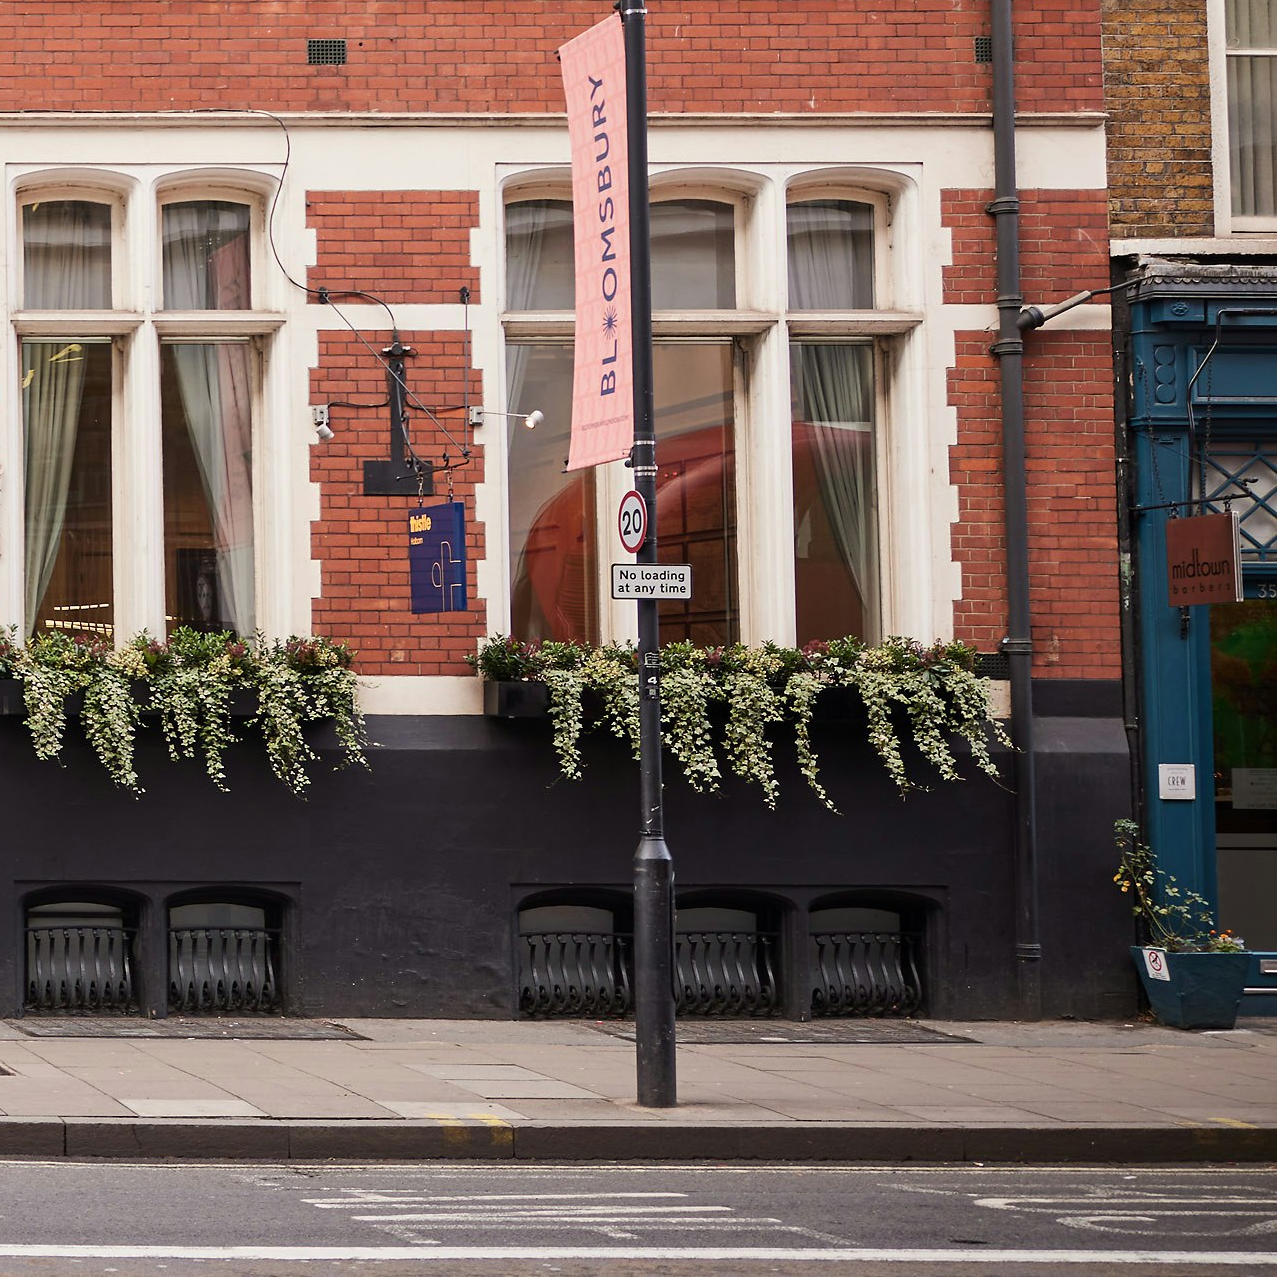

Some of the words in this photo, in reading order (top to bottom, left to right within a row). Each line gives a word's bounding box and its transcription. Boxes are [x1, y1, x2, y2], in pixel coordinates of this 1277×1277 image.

[409, 513, 432, 533] thistle
[622, 509, 642, 535] 20
[1172, 548, 1230, 579] midtown
[619, 570, 636, 580] No
[641, 570, 685, 582] loading
[618, 583, 630, 593] at
[634, 585, 656, 595] any
[659, 583, 687, 593] time
[1173, 583, 1231, 595] barbers
[647, 676, 658, 685] 4
[1167, 776, 1187, 786] CREW
